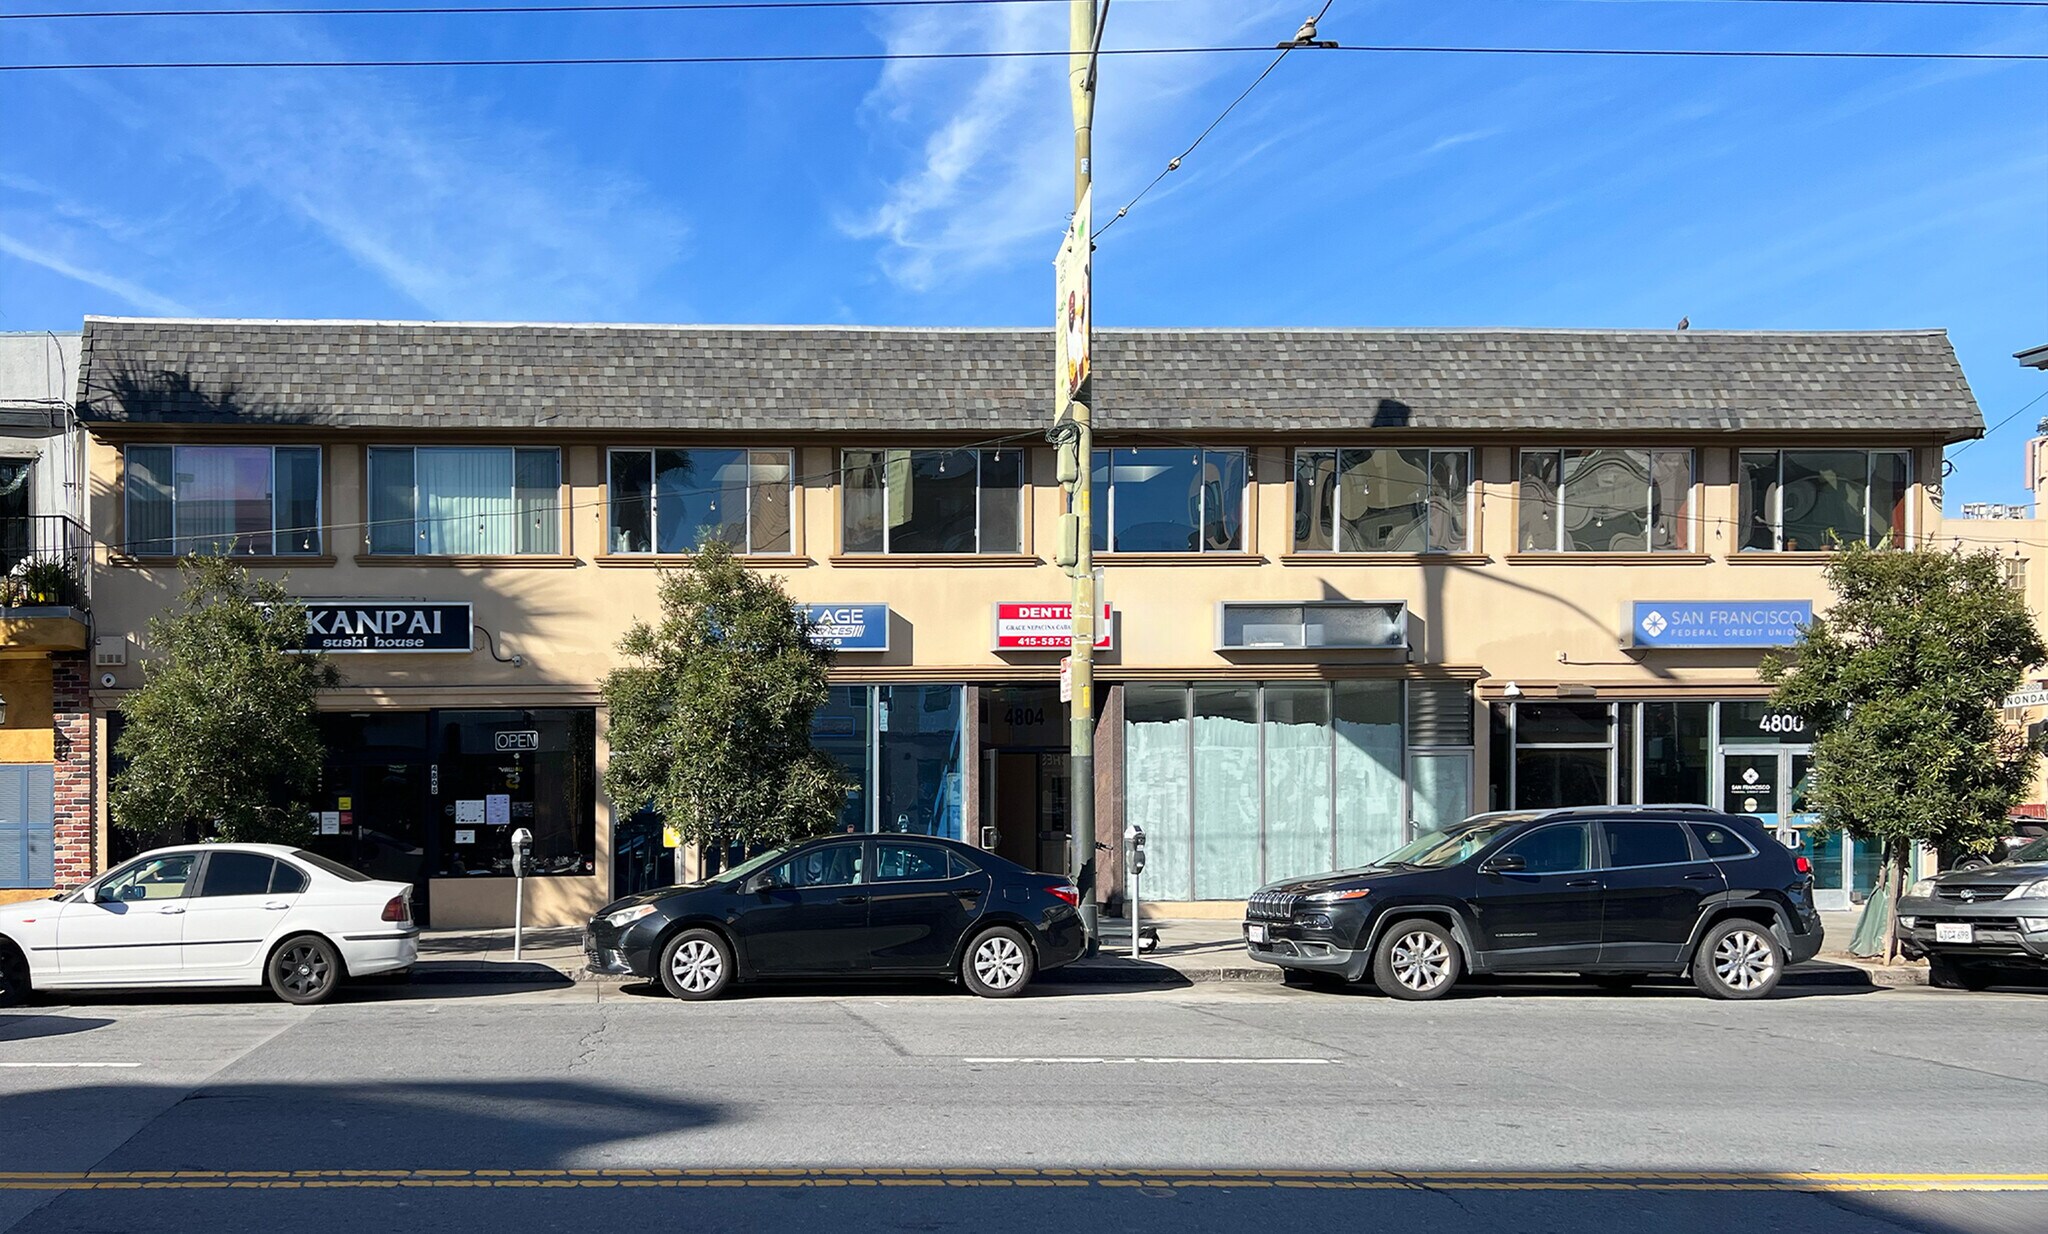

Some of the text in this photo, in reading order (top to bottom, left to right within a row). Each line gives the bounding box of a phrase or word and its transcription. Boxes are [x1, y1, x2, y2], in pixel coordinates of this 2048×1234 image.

[817, 609, 864, 624] AGE
[1019, 607, 1072, 618] DENTI
[1671, 610, 1803, 625] SAN FRANCISCO
[305, 610, 442, 634] KANPAI
[1671, 628, 1718, 637] FEDERAL
[1724, 628, 1763, 637] CREDIT
[322, 636, 425, 647] sushi house
[1004, 707, 1045, 726] 4804
[1759, 714, 1804, 732] 4800
[496, 733, 537, 748] OPEN
